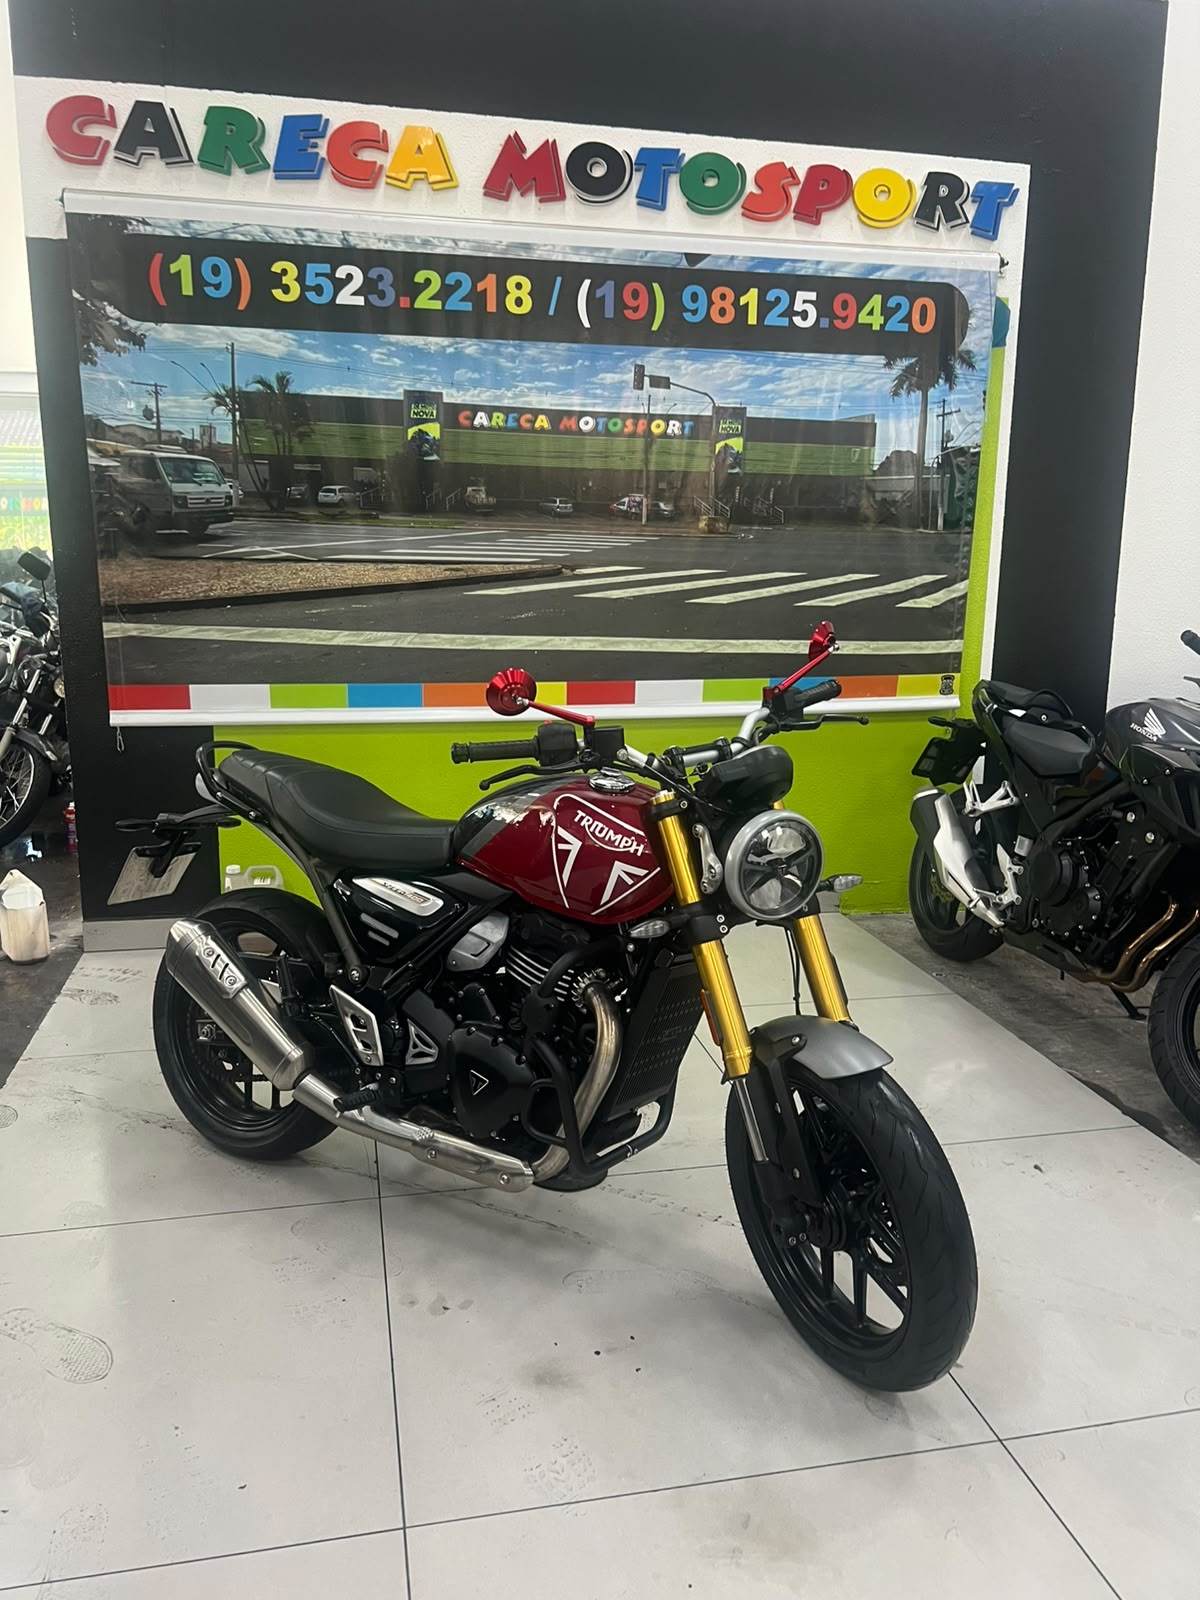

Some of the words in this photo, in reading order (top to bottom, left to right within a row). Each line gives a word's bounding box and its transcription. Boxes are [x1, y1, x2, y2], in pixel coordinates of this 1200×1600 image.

[46, 95, 459, 191] CARECA
[483, 131, 1019, 241] MOTOSPORT
[149, 252, 252, 311] (19)
[271, 260, 533, 315] 3523.2218
[577, 278, 665, 332] (19)
[682, 284, 937, 334] 98125.9420
[411, 409, 436, 418] NOVA
[458, 410, 551, 430] CARECA
[559, 416, 694, 437] MOTOSPORT
[719, 424, 741, 433] NOVA
[1129, 722, 1159, 742] HONDA
[573, 810, 645, 857] TRIUMPH
